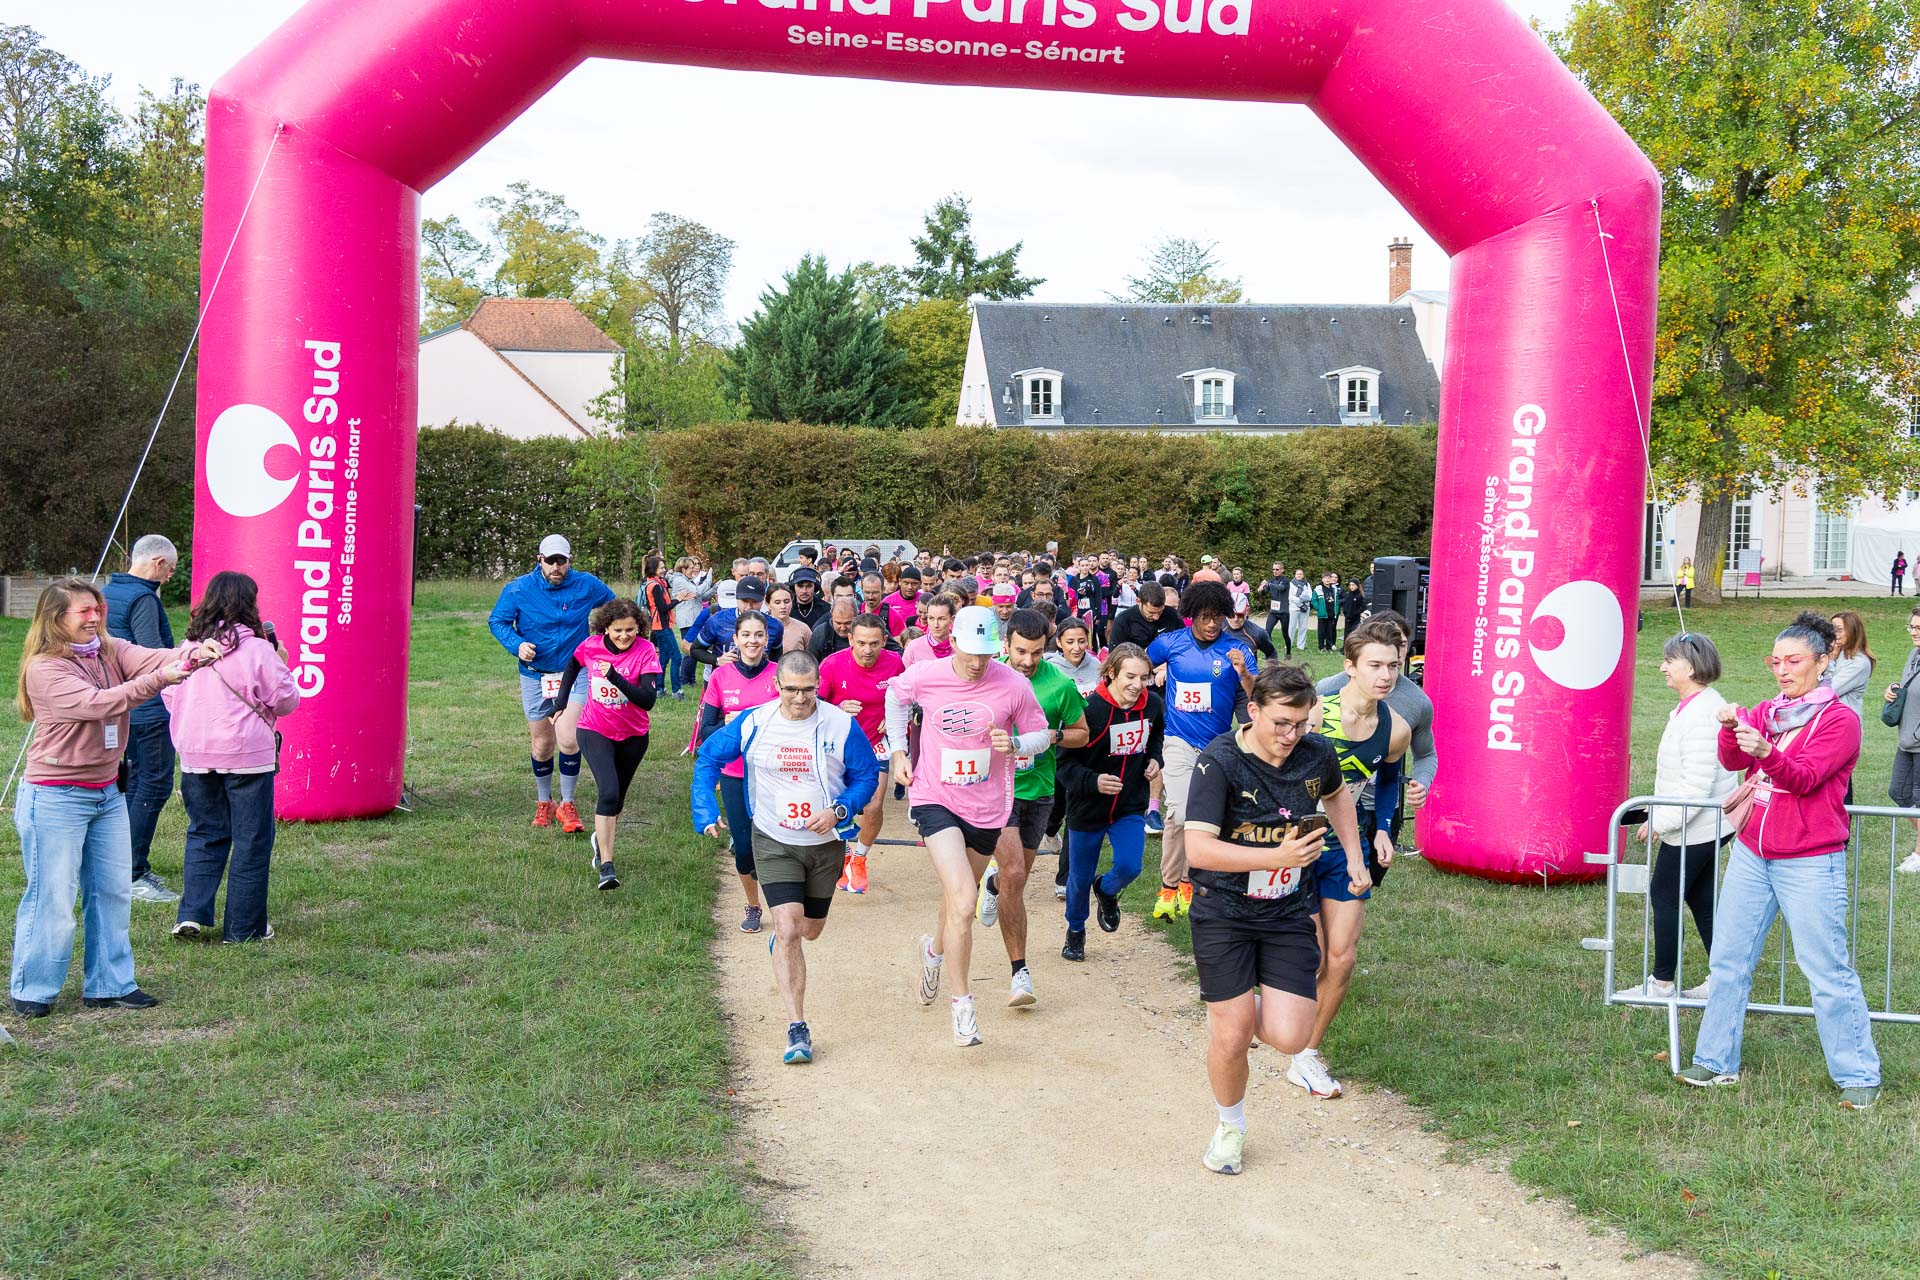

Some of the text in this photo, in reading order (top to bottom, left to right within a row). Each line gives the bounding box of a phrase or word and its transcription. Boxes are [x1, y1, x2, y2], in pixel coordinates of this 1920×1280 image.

[787, 25, 1125, 64] Seine-Essonne-Sénart
[292, 339, 341, 698] Grand Paris Sud
[337, 417, 362, 625] Seine-Essonne-Sénart
[1487, 403, 1547, 751] Grand Paris Sud
[600, 686, 618, 698] 98
[1183, 691, 1201, 704] 35
[1116, 729, 1145, 747] 137
[954, 760, 978, 775] 11
[787, 802, 812, 819] 38
[1266, 867, 1291, 886] 76
